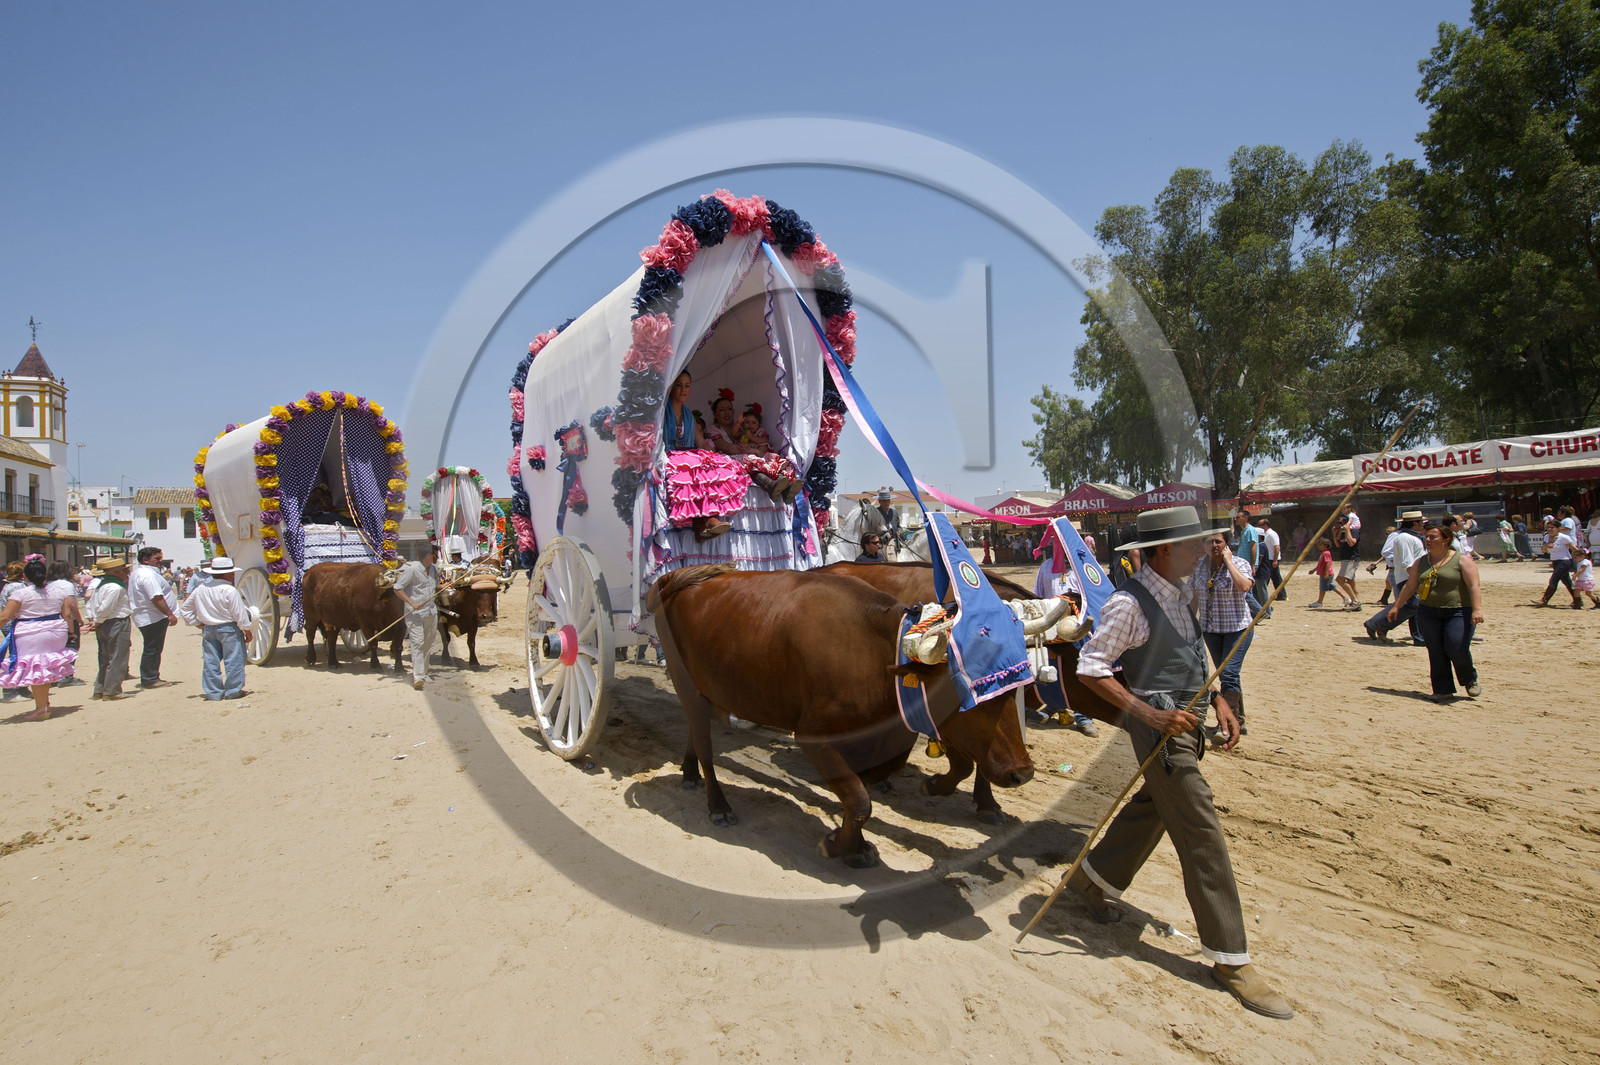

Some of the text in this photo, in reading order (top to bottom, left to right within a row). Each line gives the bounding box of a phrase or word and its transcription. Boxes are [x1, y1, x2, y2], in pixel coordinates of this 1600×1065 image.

[1361, 434, 1600, 474] CHOCOLATE Y CHUR
[1147, 489, 1198, 504] MESON
[994, 505, 1031, 515] MESON
[1063, 498, 1109, 511] BRASIL
